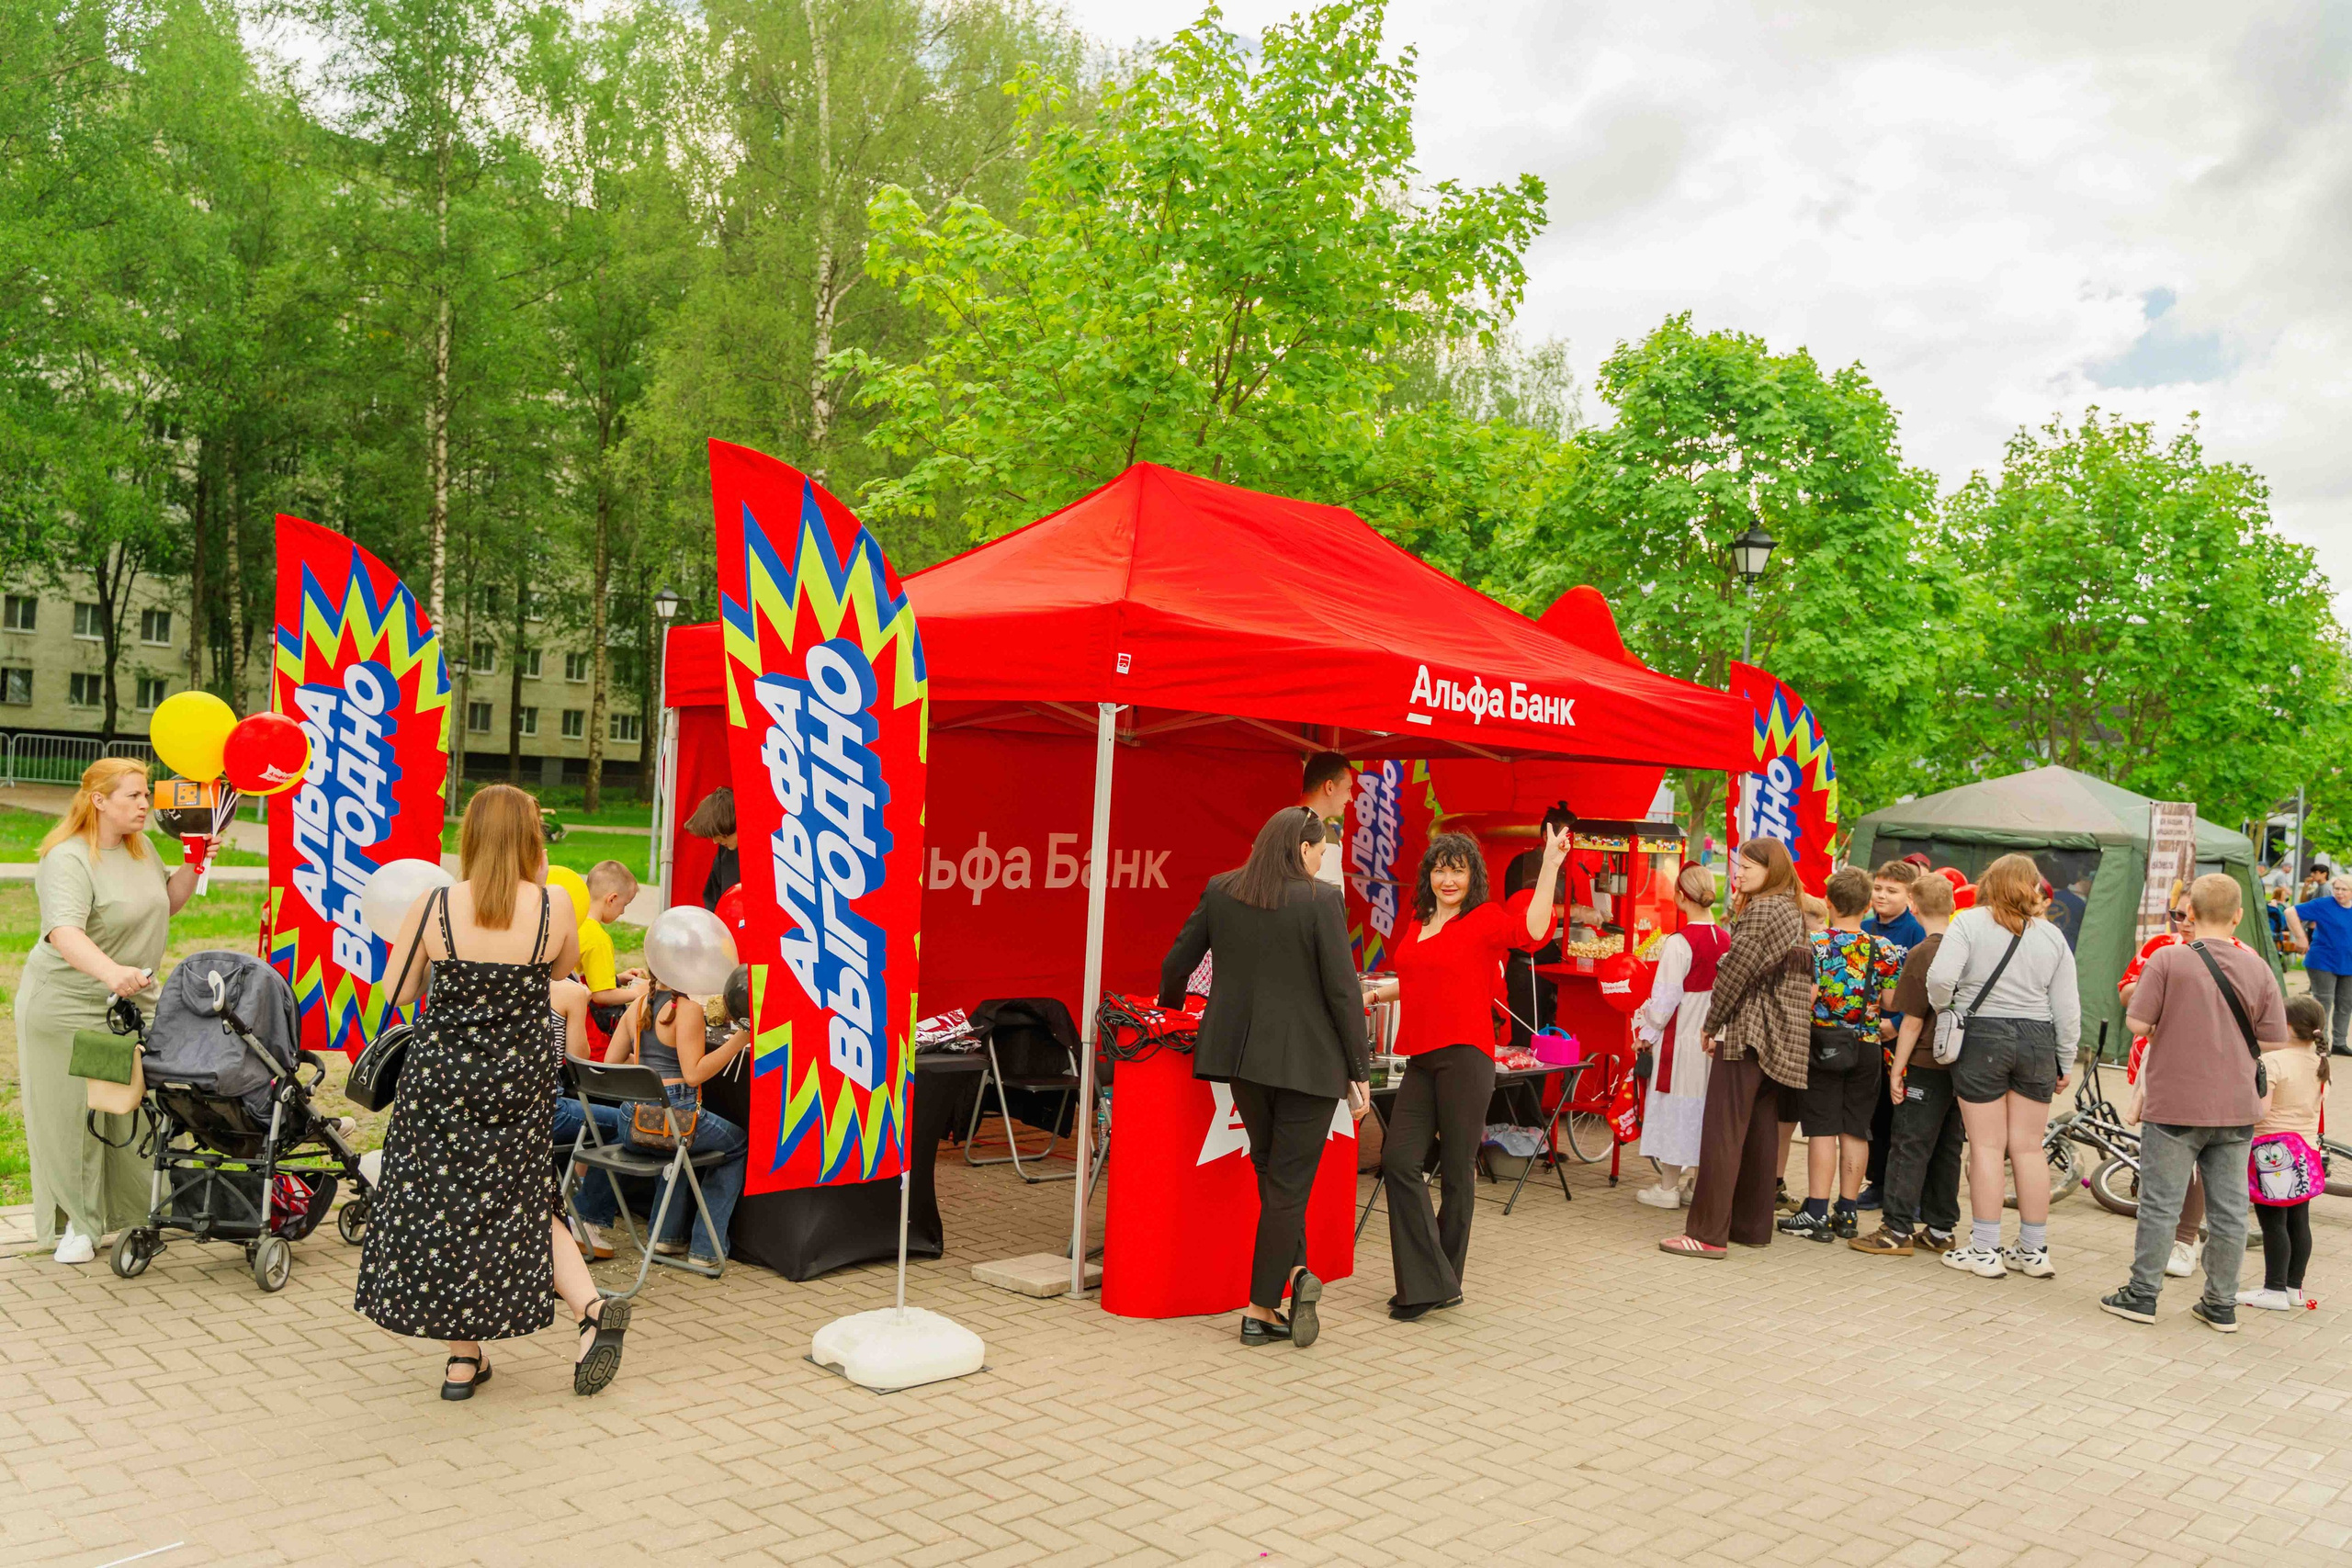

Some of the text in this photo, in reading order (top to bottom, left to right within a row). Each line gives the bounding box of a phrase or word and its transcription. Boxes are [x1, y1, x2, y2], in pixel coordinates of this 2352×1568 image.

[1407, 664, 1577, 727] Альфа Банк
[754, 679, 822, 1010] АЛЬФА
[805, 644, 877, 1092] ВЫГОДНО
[922, 831, 1032, 906] ьфа
[1351, 773, 1380, 904] АЛЬФА
[1370, 759, 1397, 940] ВЫГОДНО
